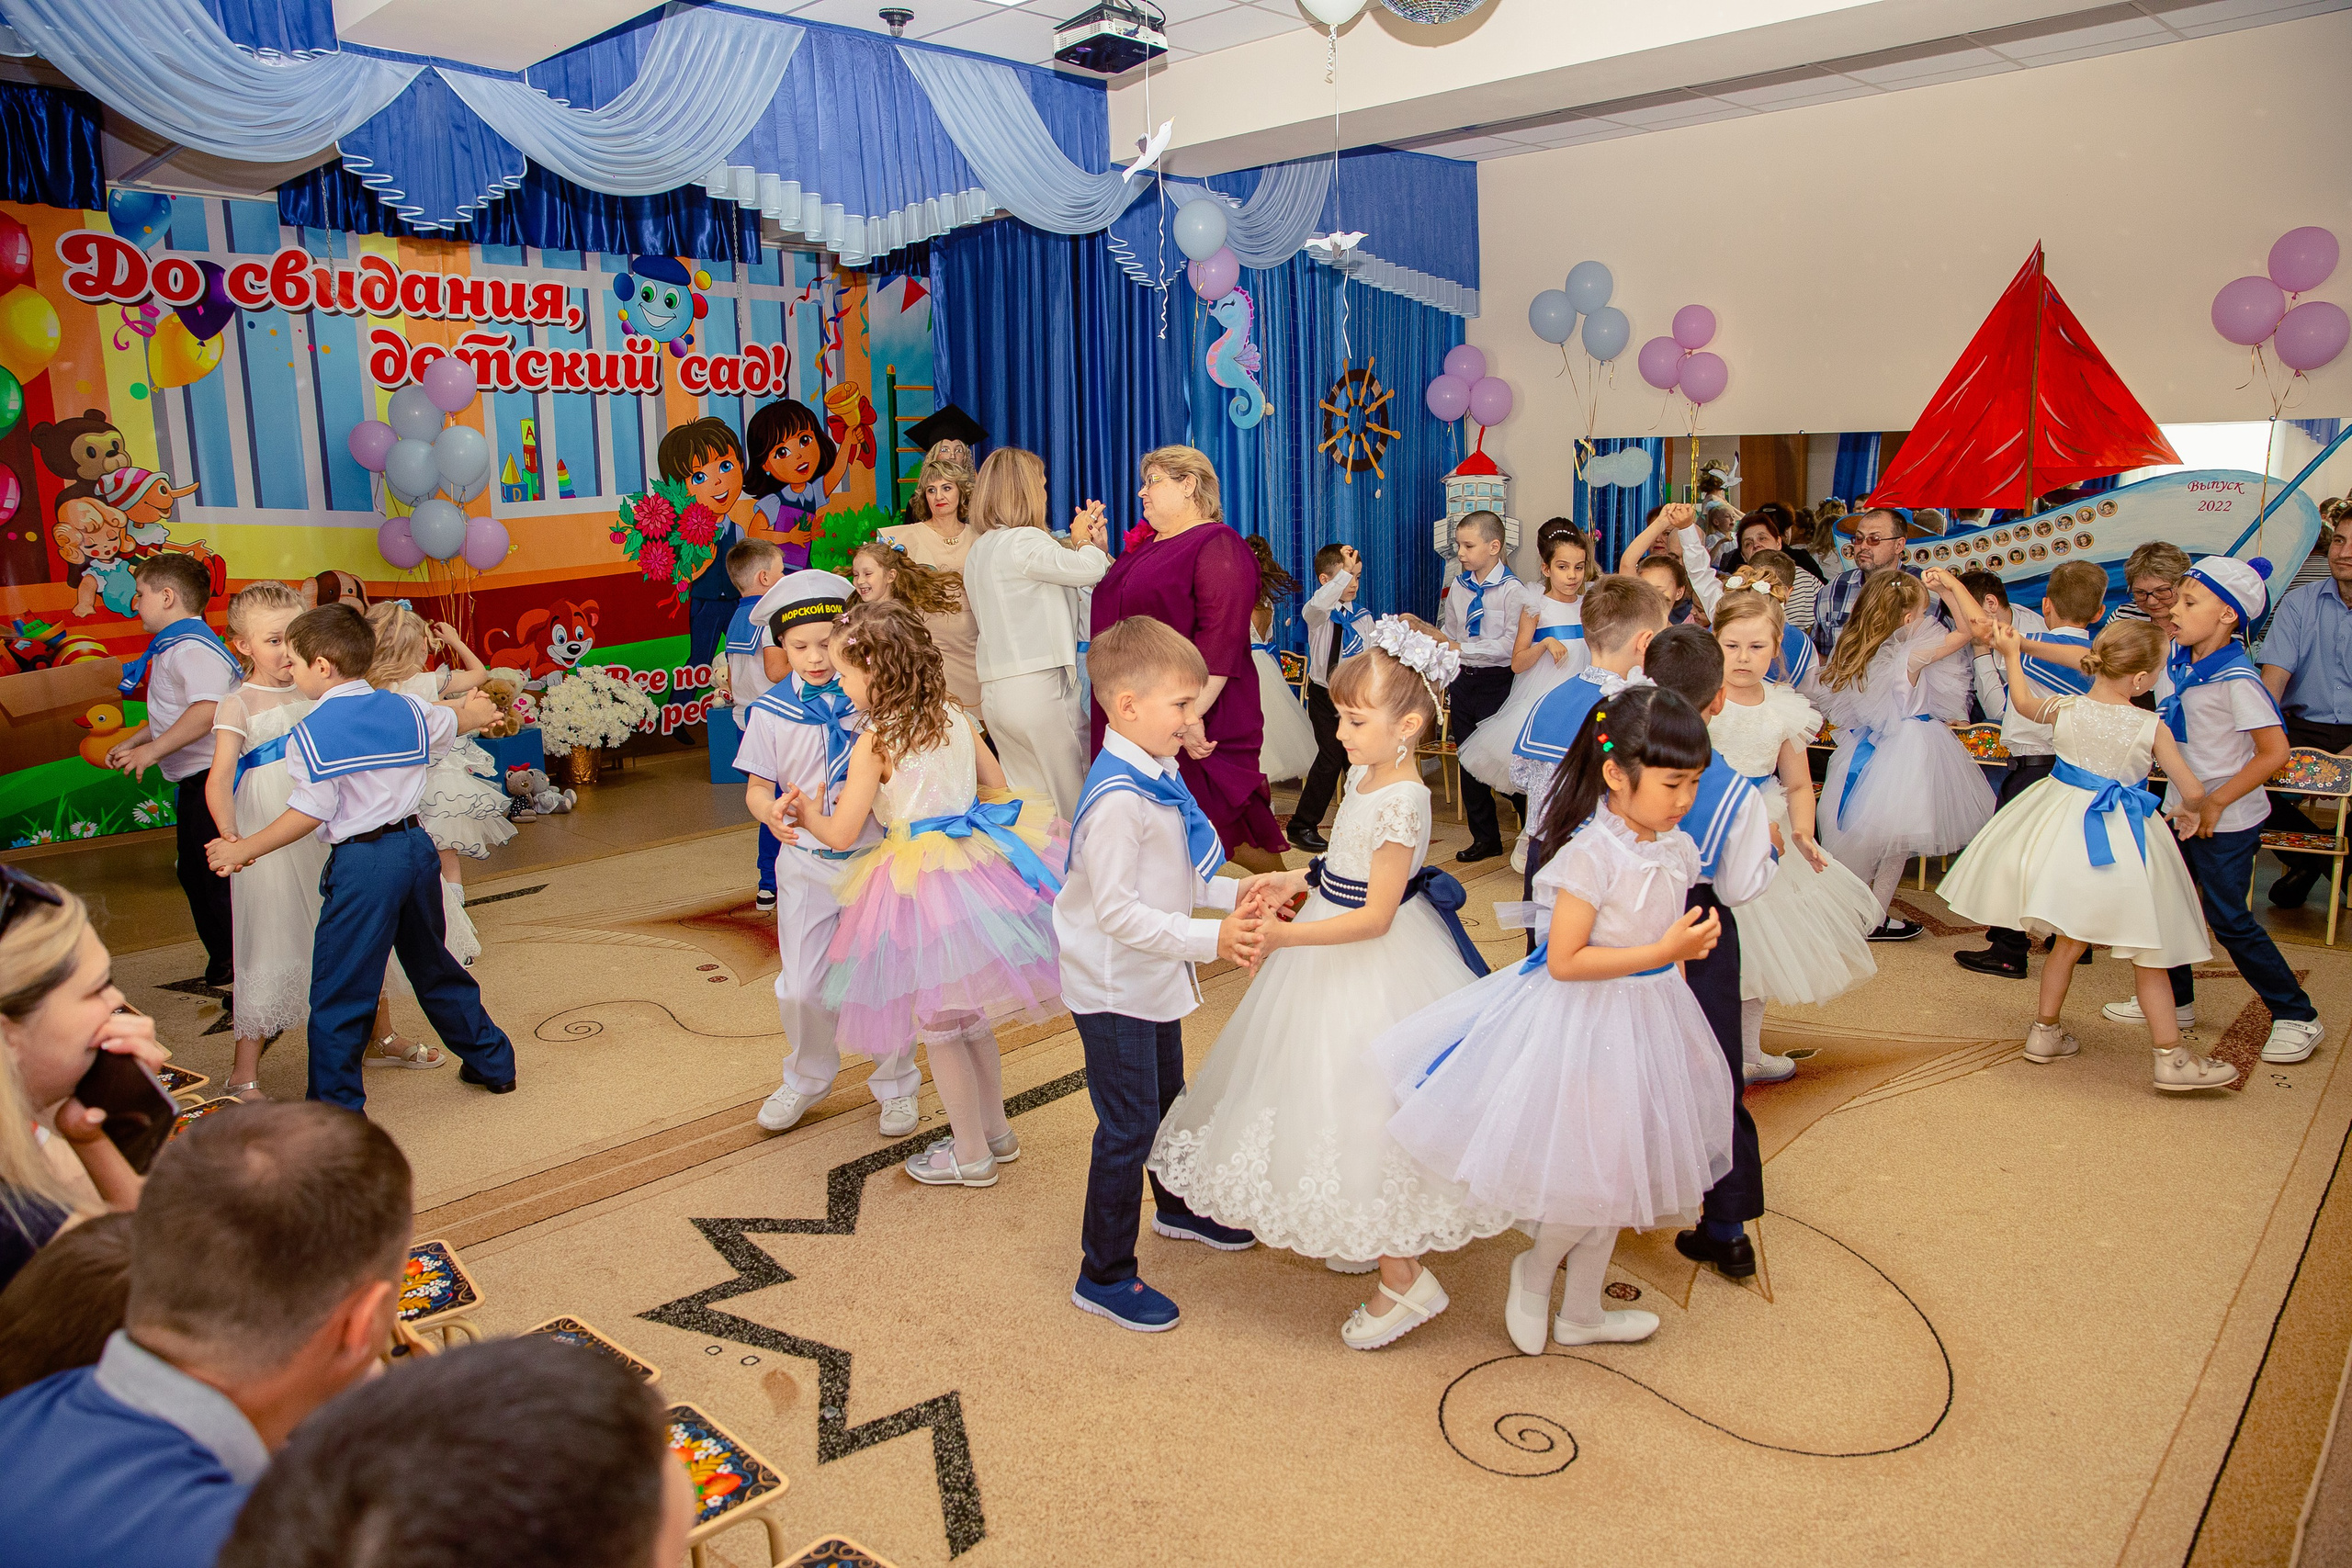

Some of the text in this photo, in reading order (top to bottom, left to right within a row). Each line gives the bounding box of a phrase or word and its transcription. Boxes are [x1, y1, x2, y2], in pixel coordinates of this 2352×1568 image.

[57, 231, 585, 331] До свидания,
[368, 326, 789, 393] детский сад!
[2188, 479, 2245, 495] Выпуск
[2198, 500, 2233, 512] 2022
[781, 603, 843, 623] МОРСКОЙ ВОЛК
